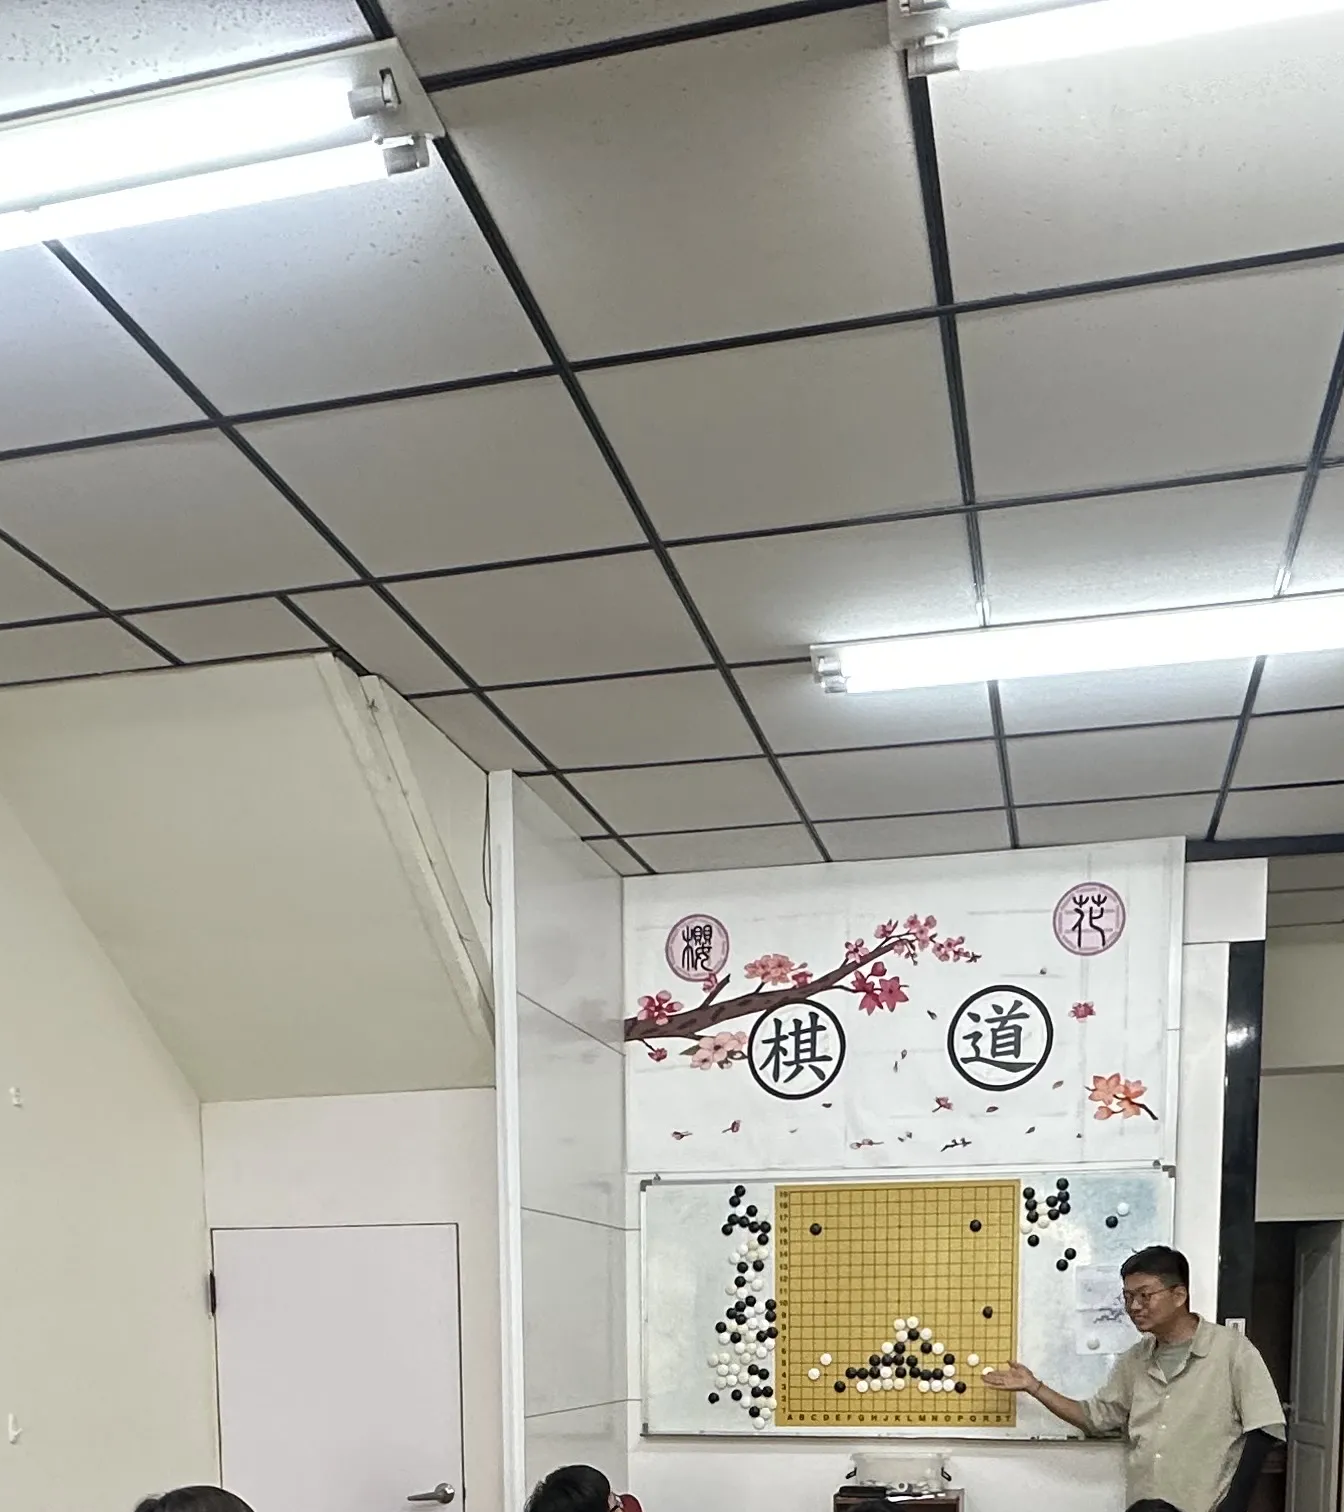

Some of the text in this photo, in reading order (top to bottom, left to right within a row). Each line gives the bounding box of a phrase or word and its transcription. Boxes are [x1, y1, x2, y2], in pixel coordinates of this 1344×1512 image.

[682, 894, 1107, 971] 櫻 花
[759, 1000, 1037, 1084] 棋 道
